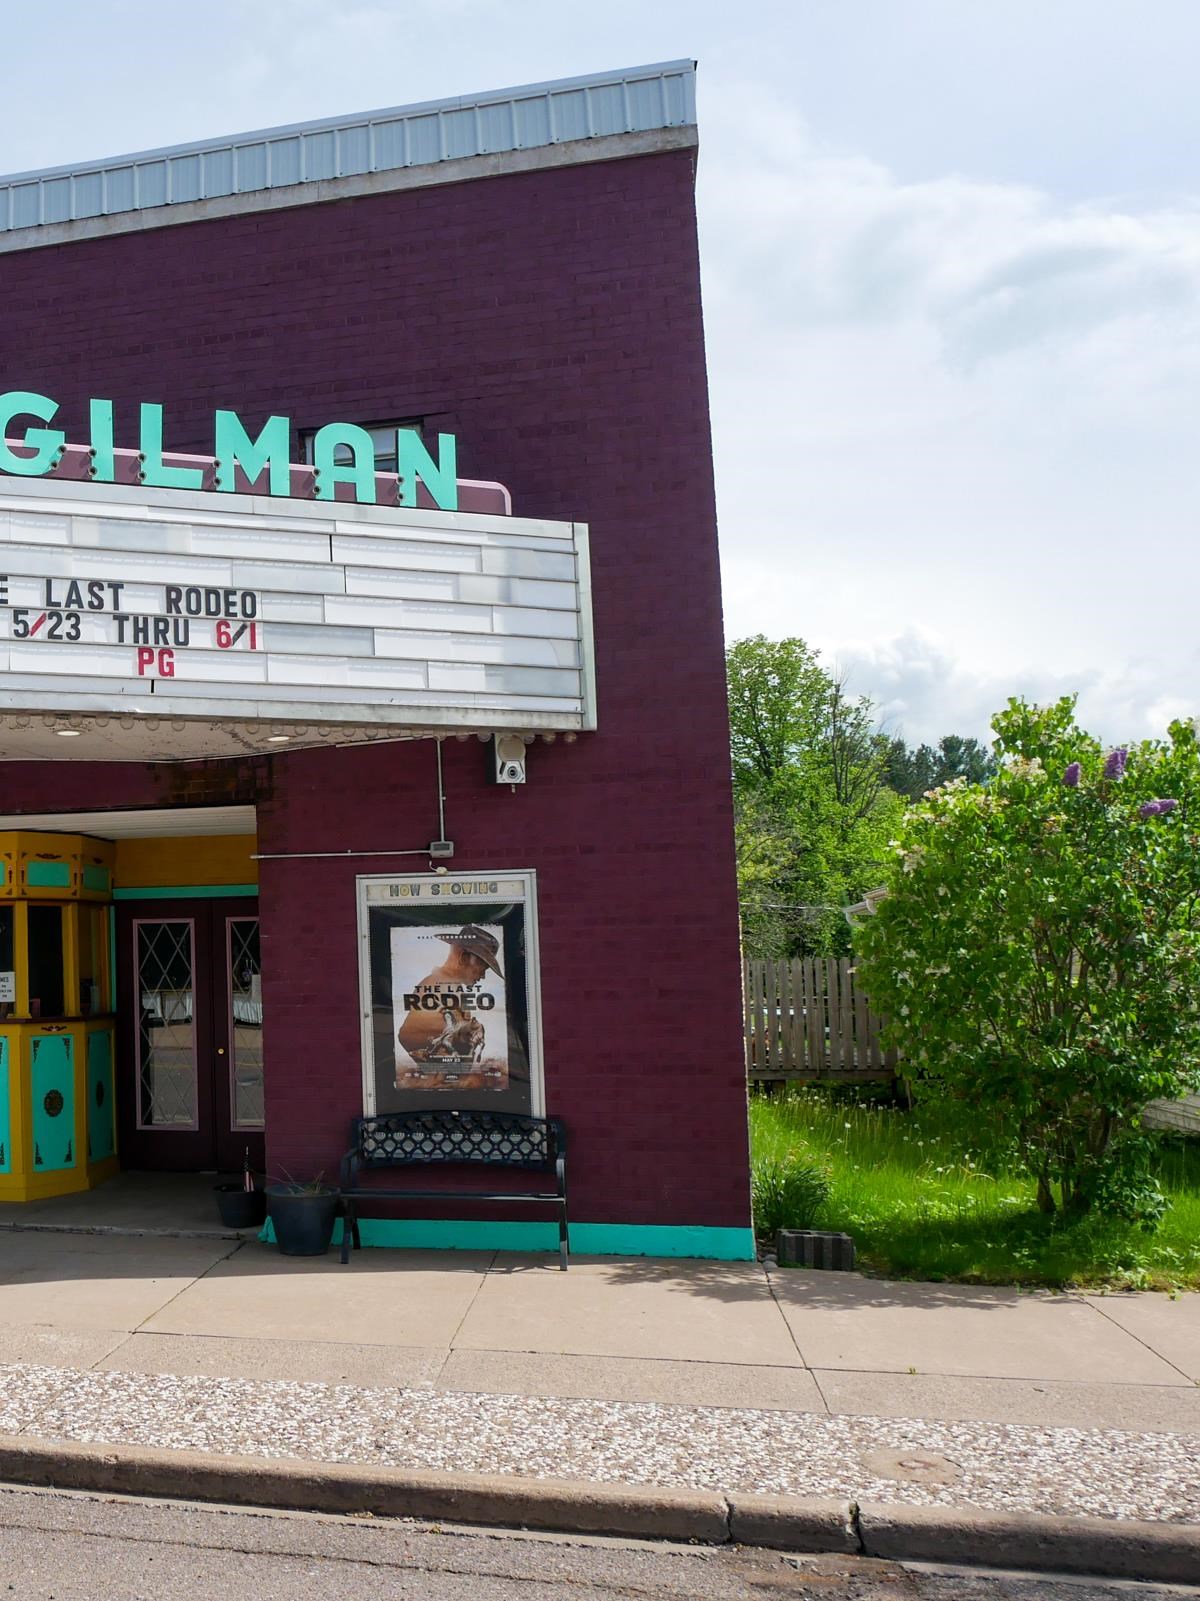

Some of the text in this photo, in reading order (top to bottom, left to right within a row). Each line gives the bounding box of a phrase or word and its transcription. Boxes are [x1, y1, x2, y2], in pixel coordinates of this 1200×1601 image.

[45, 579, 124, 612] LAST
[166, 585, 257, 619] RODEO
[13, 609, 257, 650] 5/23 THRU 6/1
[138, 647, 175, 677] PG
[389, 881, 497, 897] NOW SOWING
[415, 985, 482, 993] THE LAST
[403, 993, 495, 1011] RODEO
